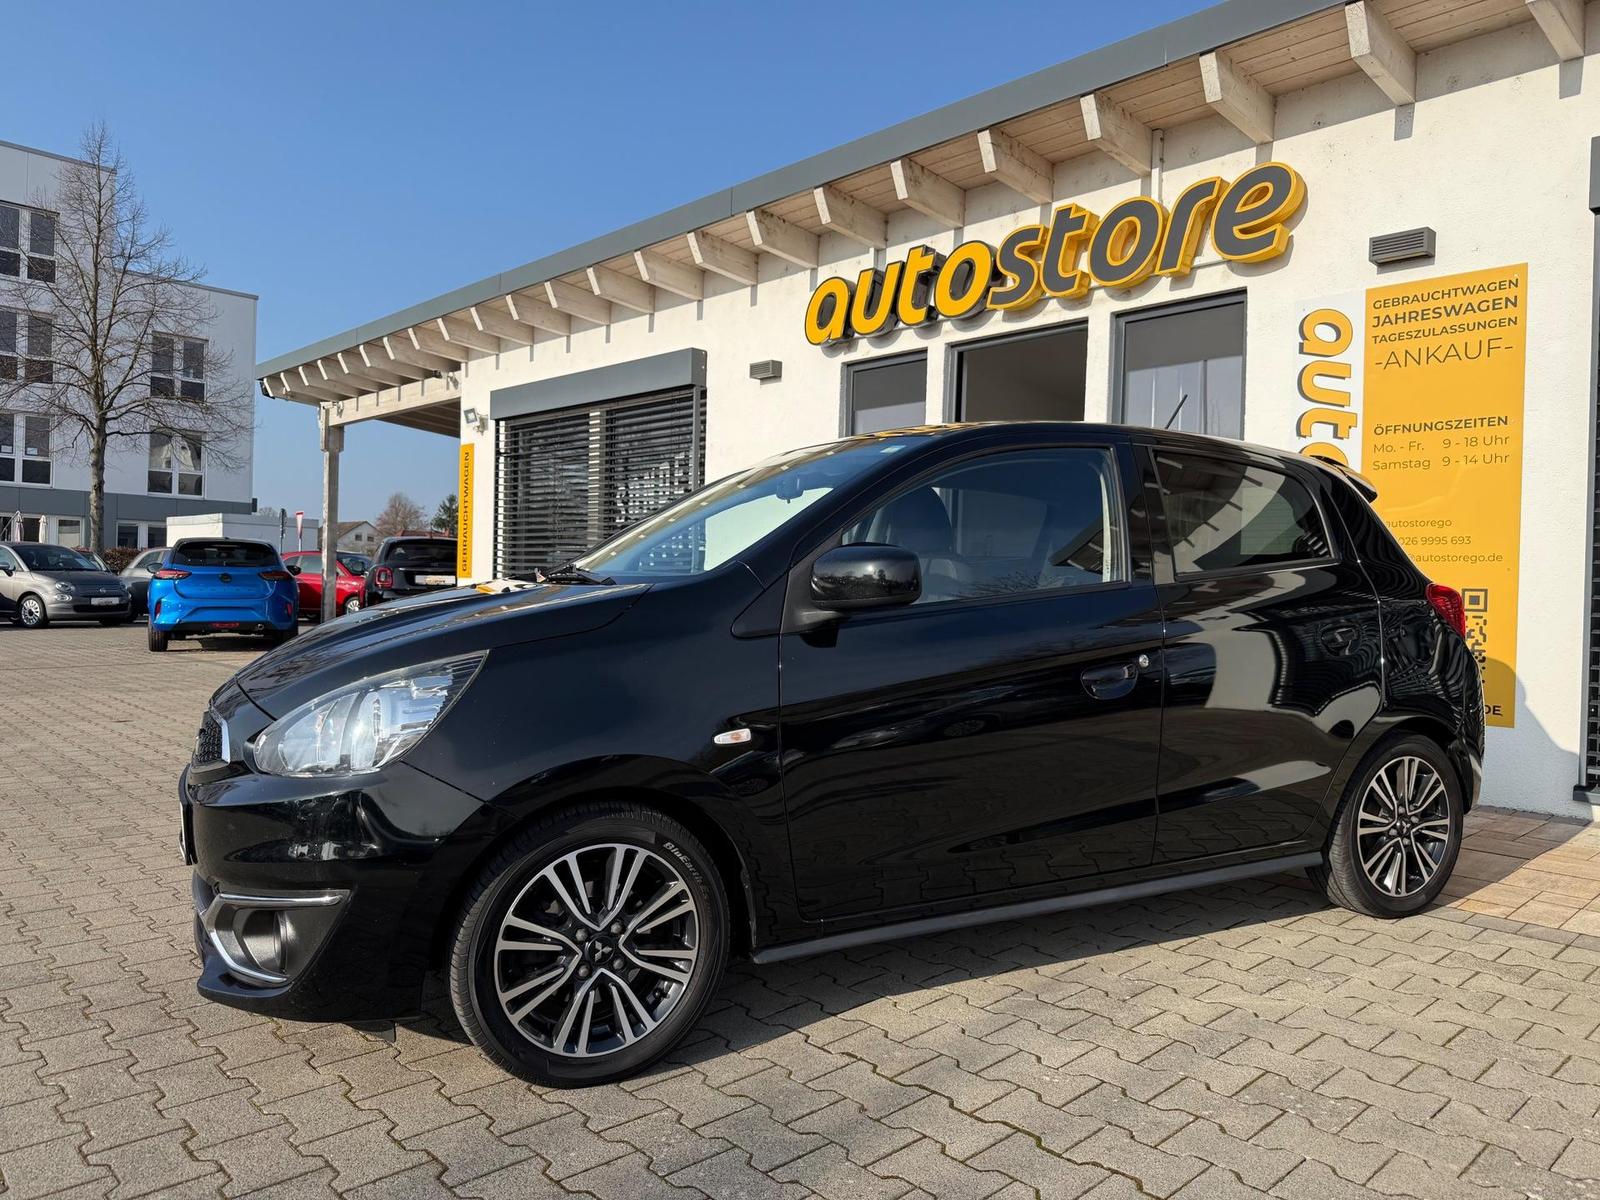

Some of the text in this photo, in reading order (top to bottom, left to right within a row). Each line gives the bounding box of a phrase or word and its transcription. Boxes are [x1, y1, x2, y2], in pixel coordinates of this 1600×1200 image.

[804, 161, 1307, 346] autostore
[1373, 278, 1519, 310] GEBRAUCHTWAGEN
[1372, 295, 1518, 328] JAHRESWAGEN
[1372, 316, 1518, 345] TAGESZULASSUNGEN
[1375, 337, 1513, 370] -ANKAUF-
[1374, 415, 1509, 436] ÖFFNUNGSZEITEN
[1373, 443, 1396, 454] Mo.
[1408, 440, 1425, 452] Fr.
[1442, 438, 1451, 449] 9
[1465, 436, 1478, 448] 18
[1483, 434, 1510, 446] Uhr
[1372, 459, 1431, 471] Samstag
[1442, 456, 1451, 467] 9
[1464, 454, 1478, 465] 14
[1482, 453, 1510, 464] Uhr
[461, 451, 470, 572] GEBRAUCHTWAGEN
[1420, 536, 1448, 546] 9995
[1450, 535, 1472, 545] 693
